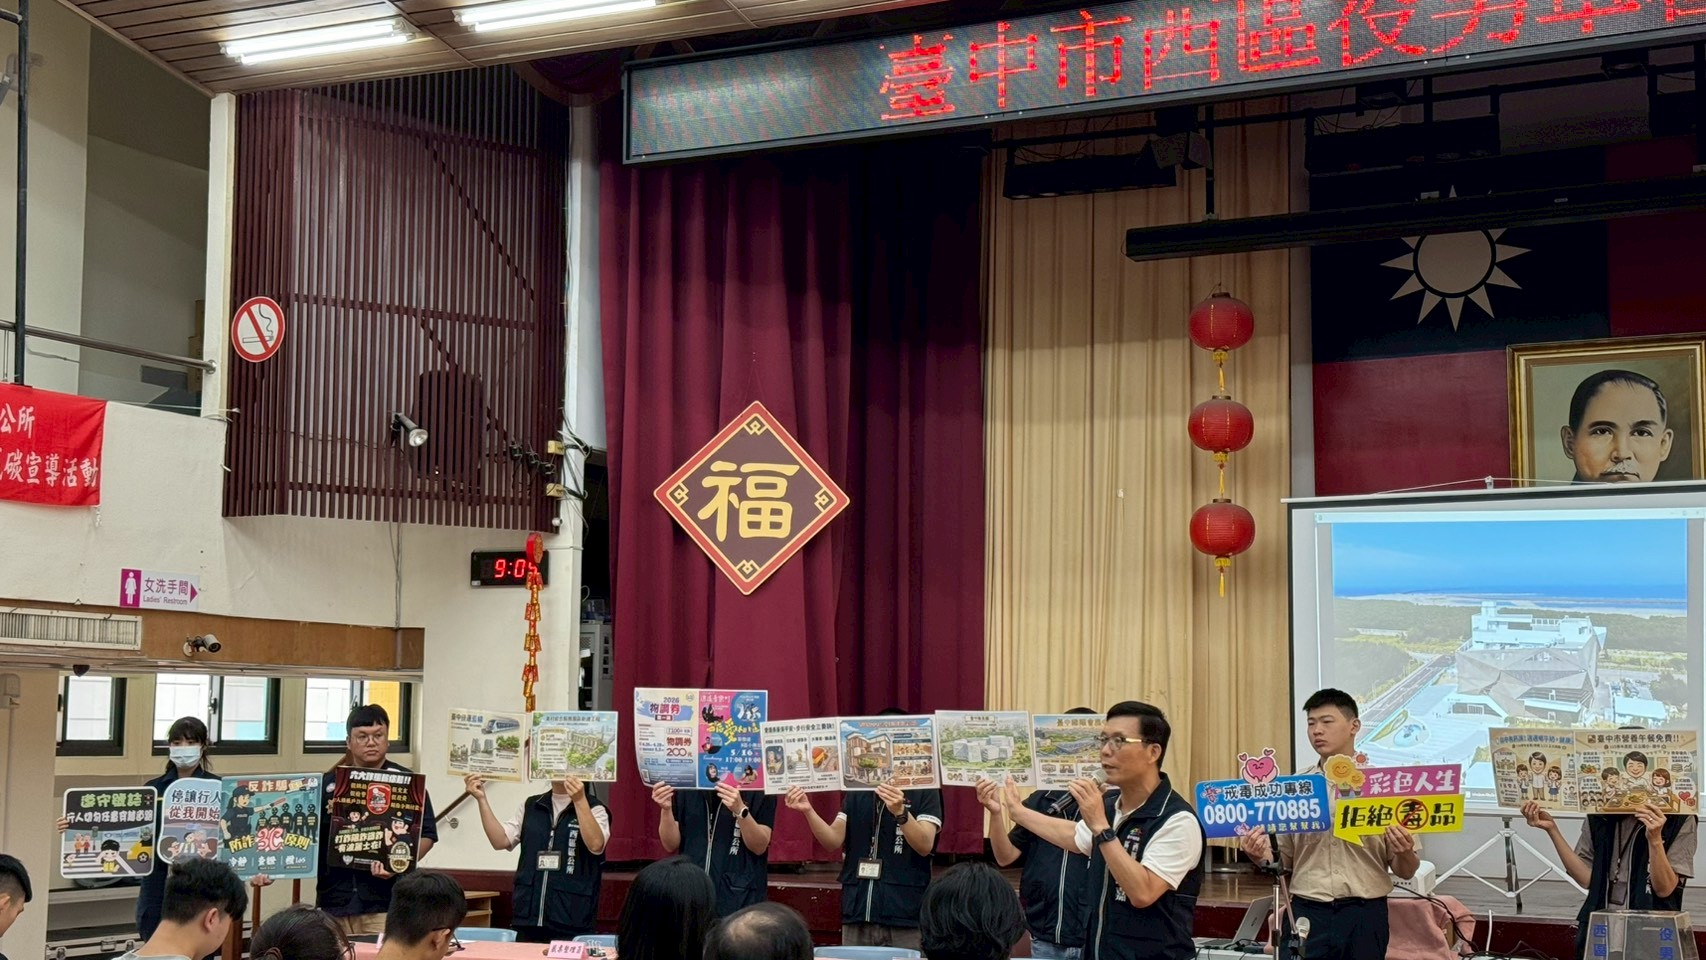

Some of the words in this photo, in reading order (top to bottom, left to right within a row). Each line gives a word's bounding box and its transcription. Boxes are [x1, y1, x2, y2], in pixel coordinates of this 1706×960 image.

[0, 402, 35, 439] 公所
[0, 448, 98, 488] 碳宣導活動
[697, 460, 800, 542] 福
[143, 577, 189, 596] 女洗手間
[163, 596, 188, 605] Restroom
[1223, 781, 1314, 801] 戒毒成功專線
[1368, 769, 1456, 795] 彩色人生
[171, 789, 221, 803] 停讓行人
[169, 805, 220, 819] 從我開始
[1203, 799, 1322, 825] 0800-770885
[1341, 800, 1456, 829] 拒絕毒品
